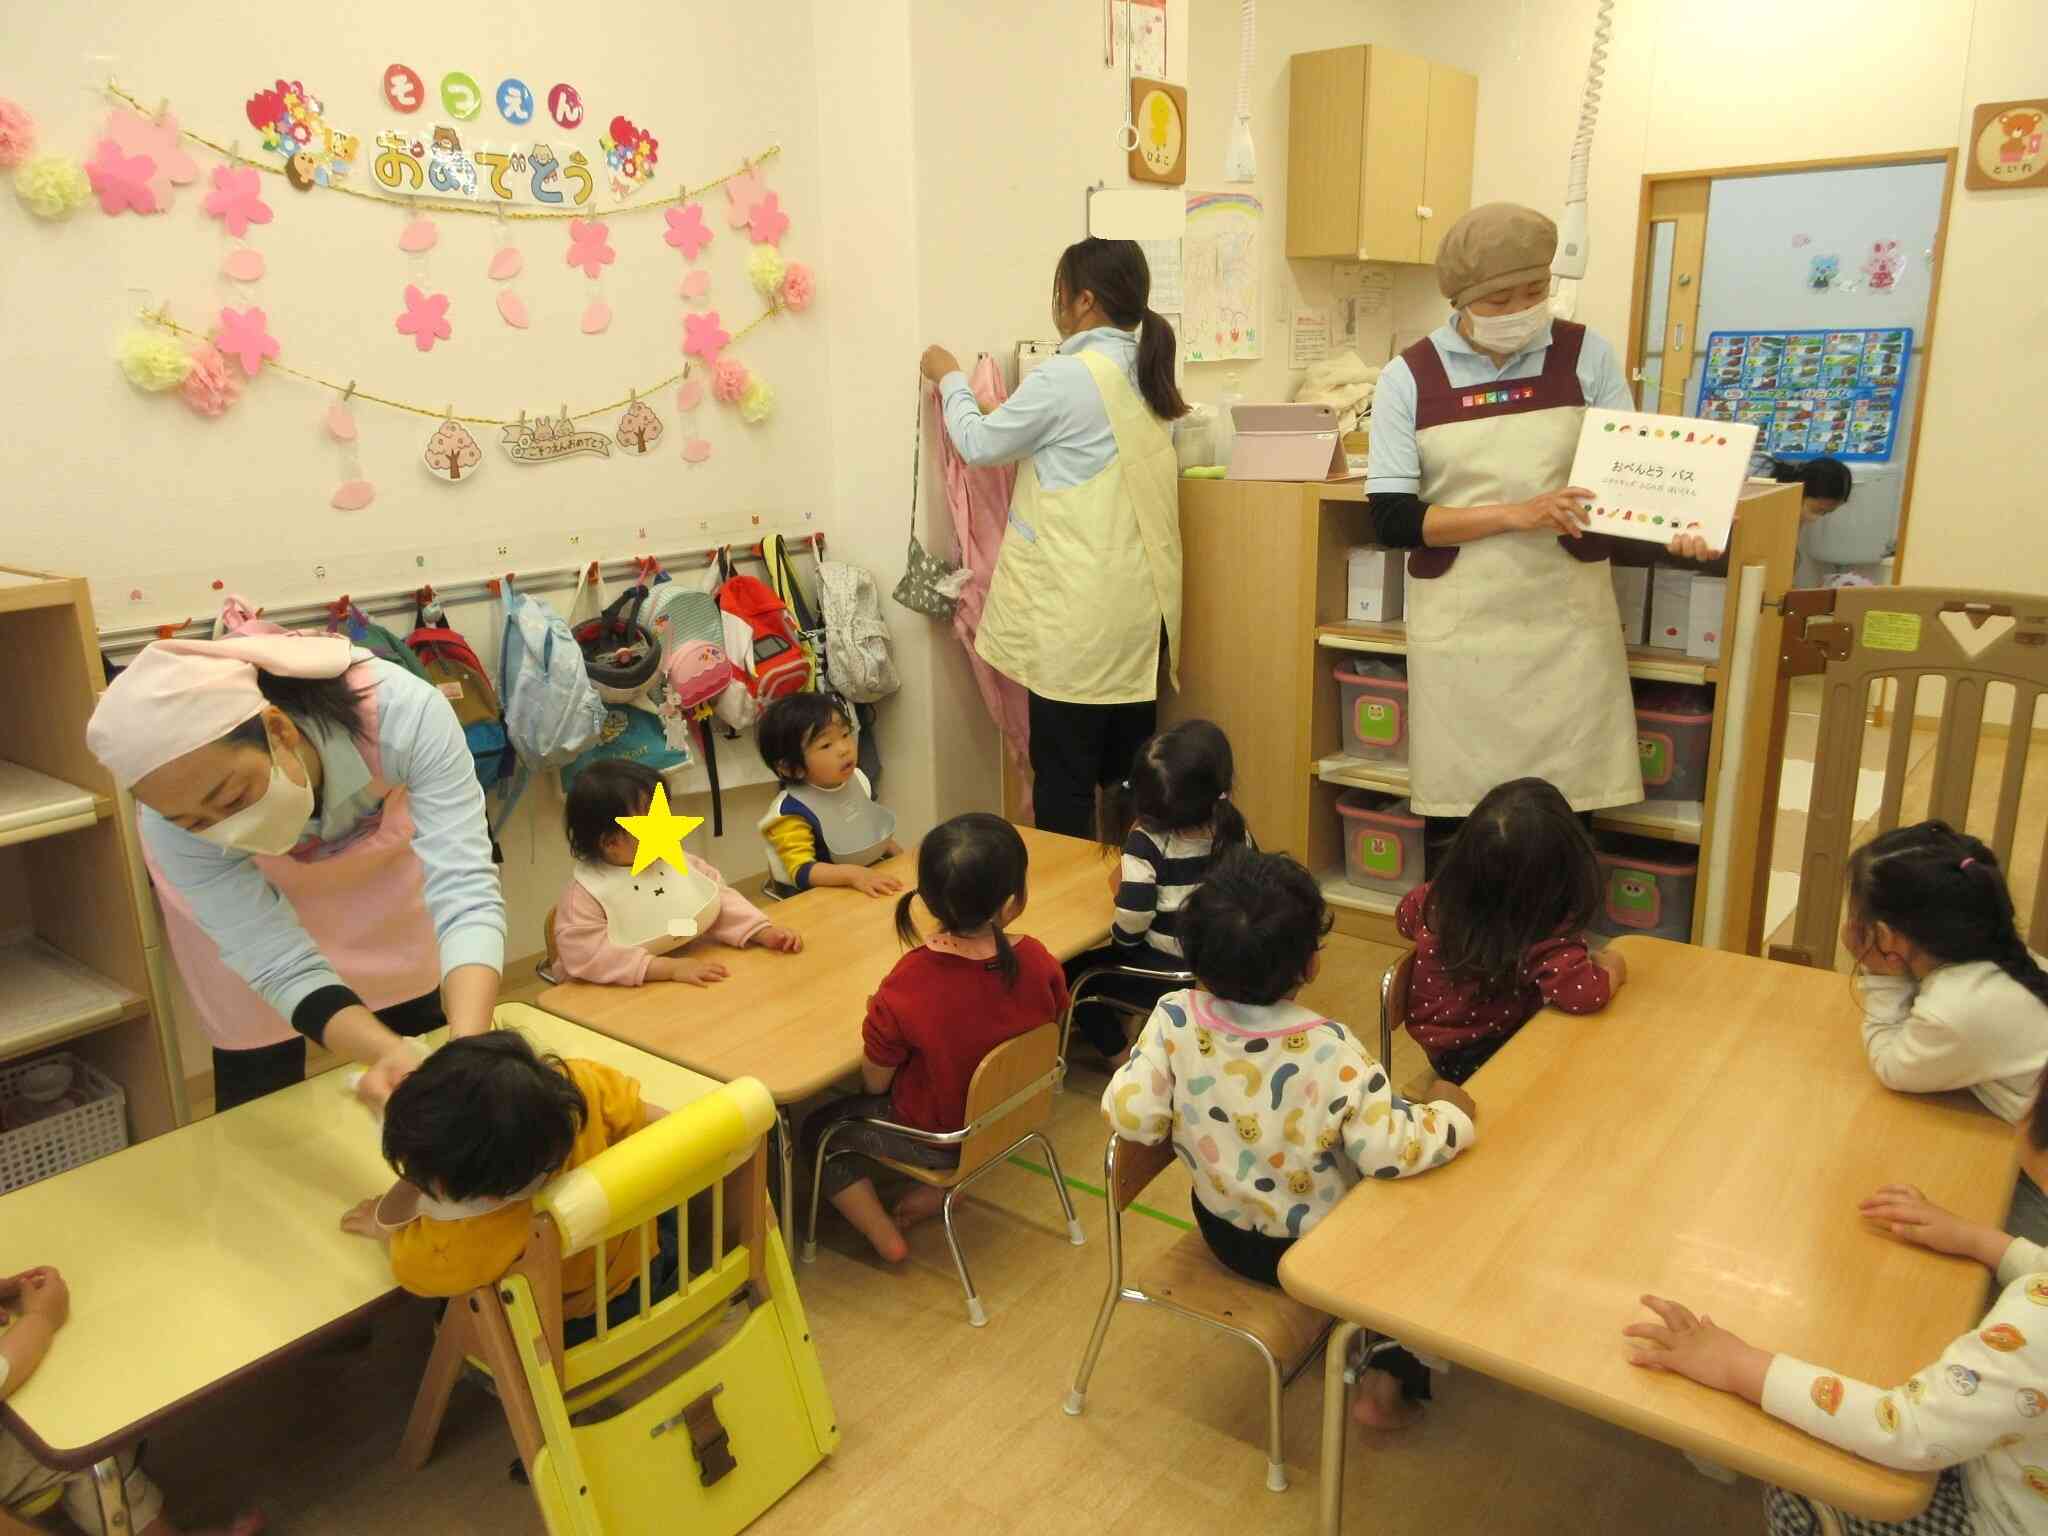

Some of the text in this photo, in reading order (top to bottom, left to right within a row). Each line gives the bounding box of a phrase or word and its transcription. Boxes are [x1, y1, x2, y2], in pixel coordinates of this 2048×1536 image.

[389, 74, 584, 122] そつえん
[374, 129, 594, 206] おめでとう
[1611, 460, 1695, 483] おべんとう バス
